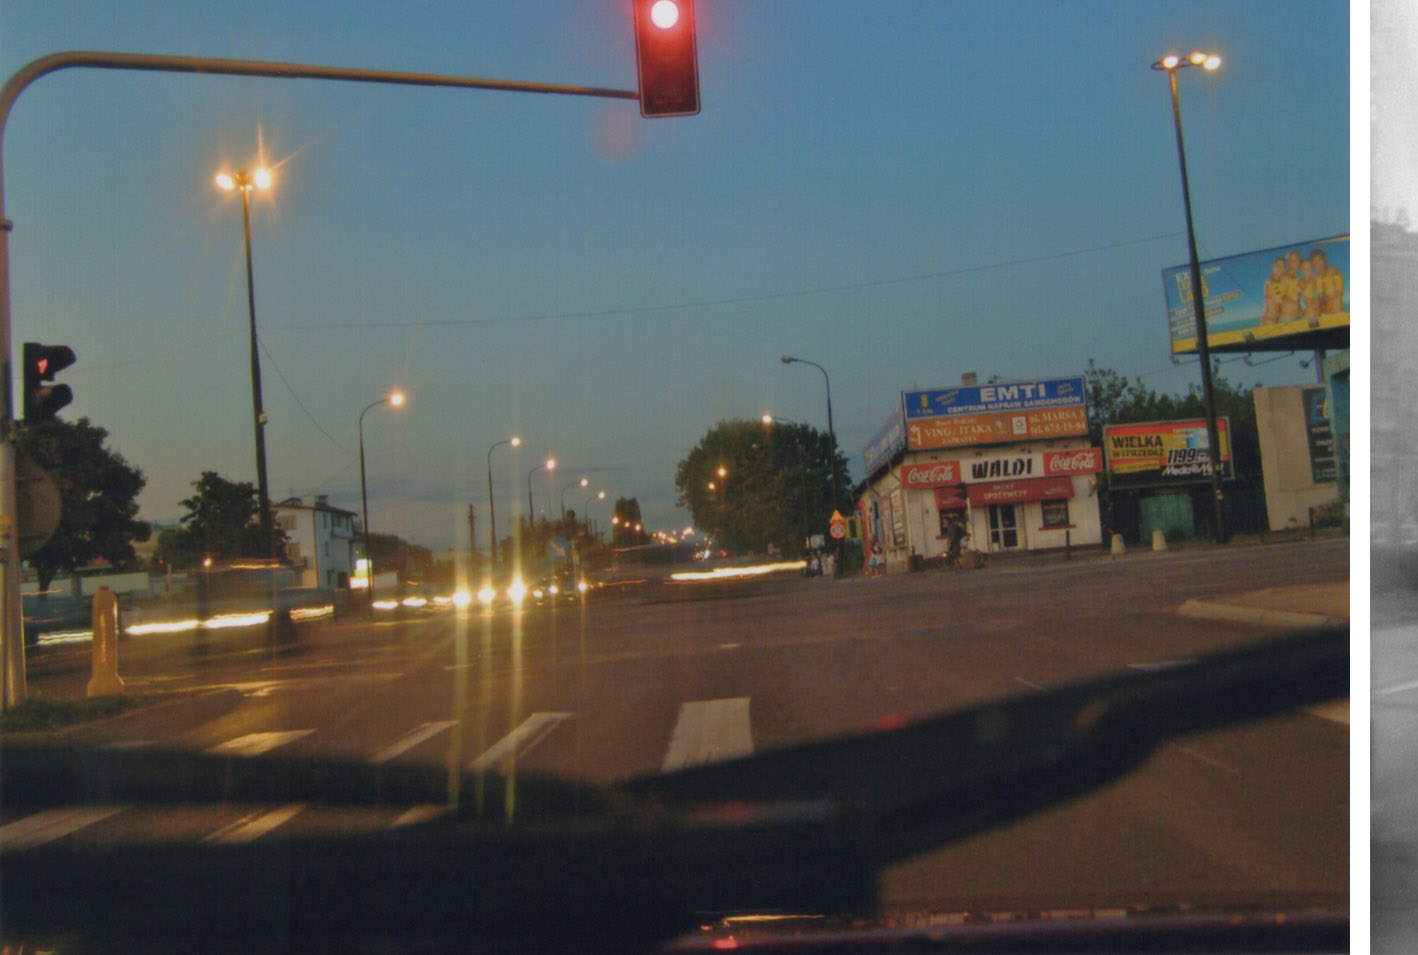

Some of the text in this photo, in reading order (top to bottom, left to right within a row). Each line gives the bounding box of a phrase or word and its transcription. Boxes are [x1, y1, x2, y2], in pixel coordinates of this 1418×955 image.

[981, 384, 1046, 403] EMTI
[947, 403, 987, 415] CENTRUM
[988, 400, 1021, 411] NAPRAW
[925, 427, 951, 438] VING
[959, 423, 993, 435] ITAKA
[1112, 435, 1164, 449] WIELKA
